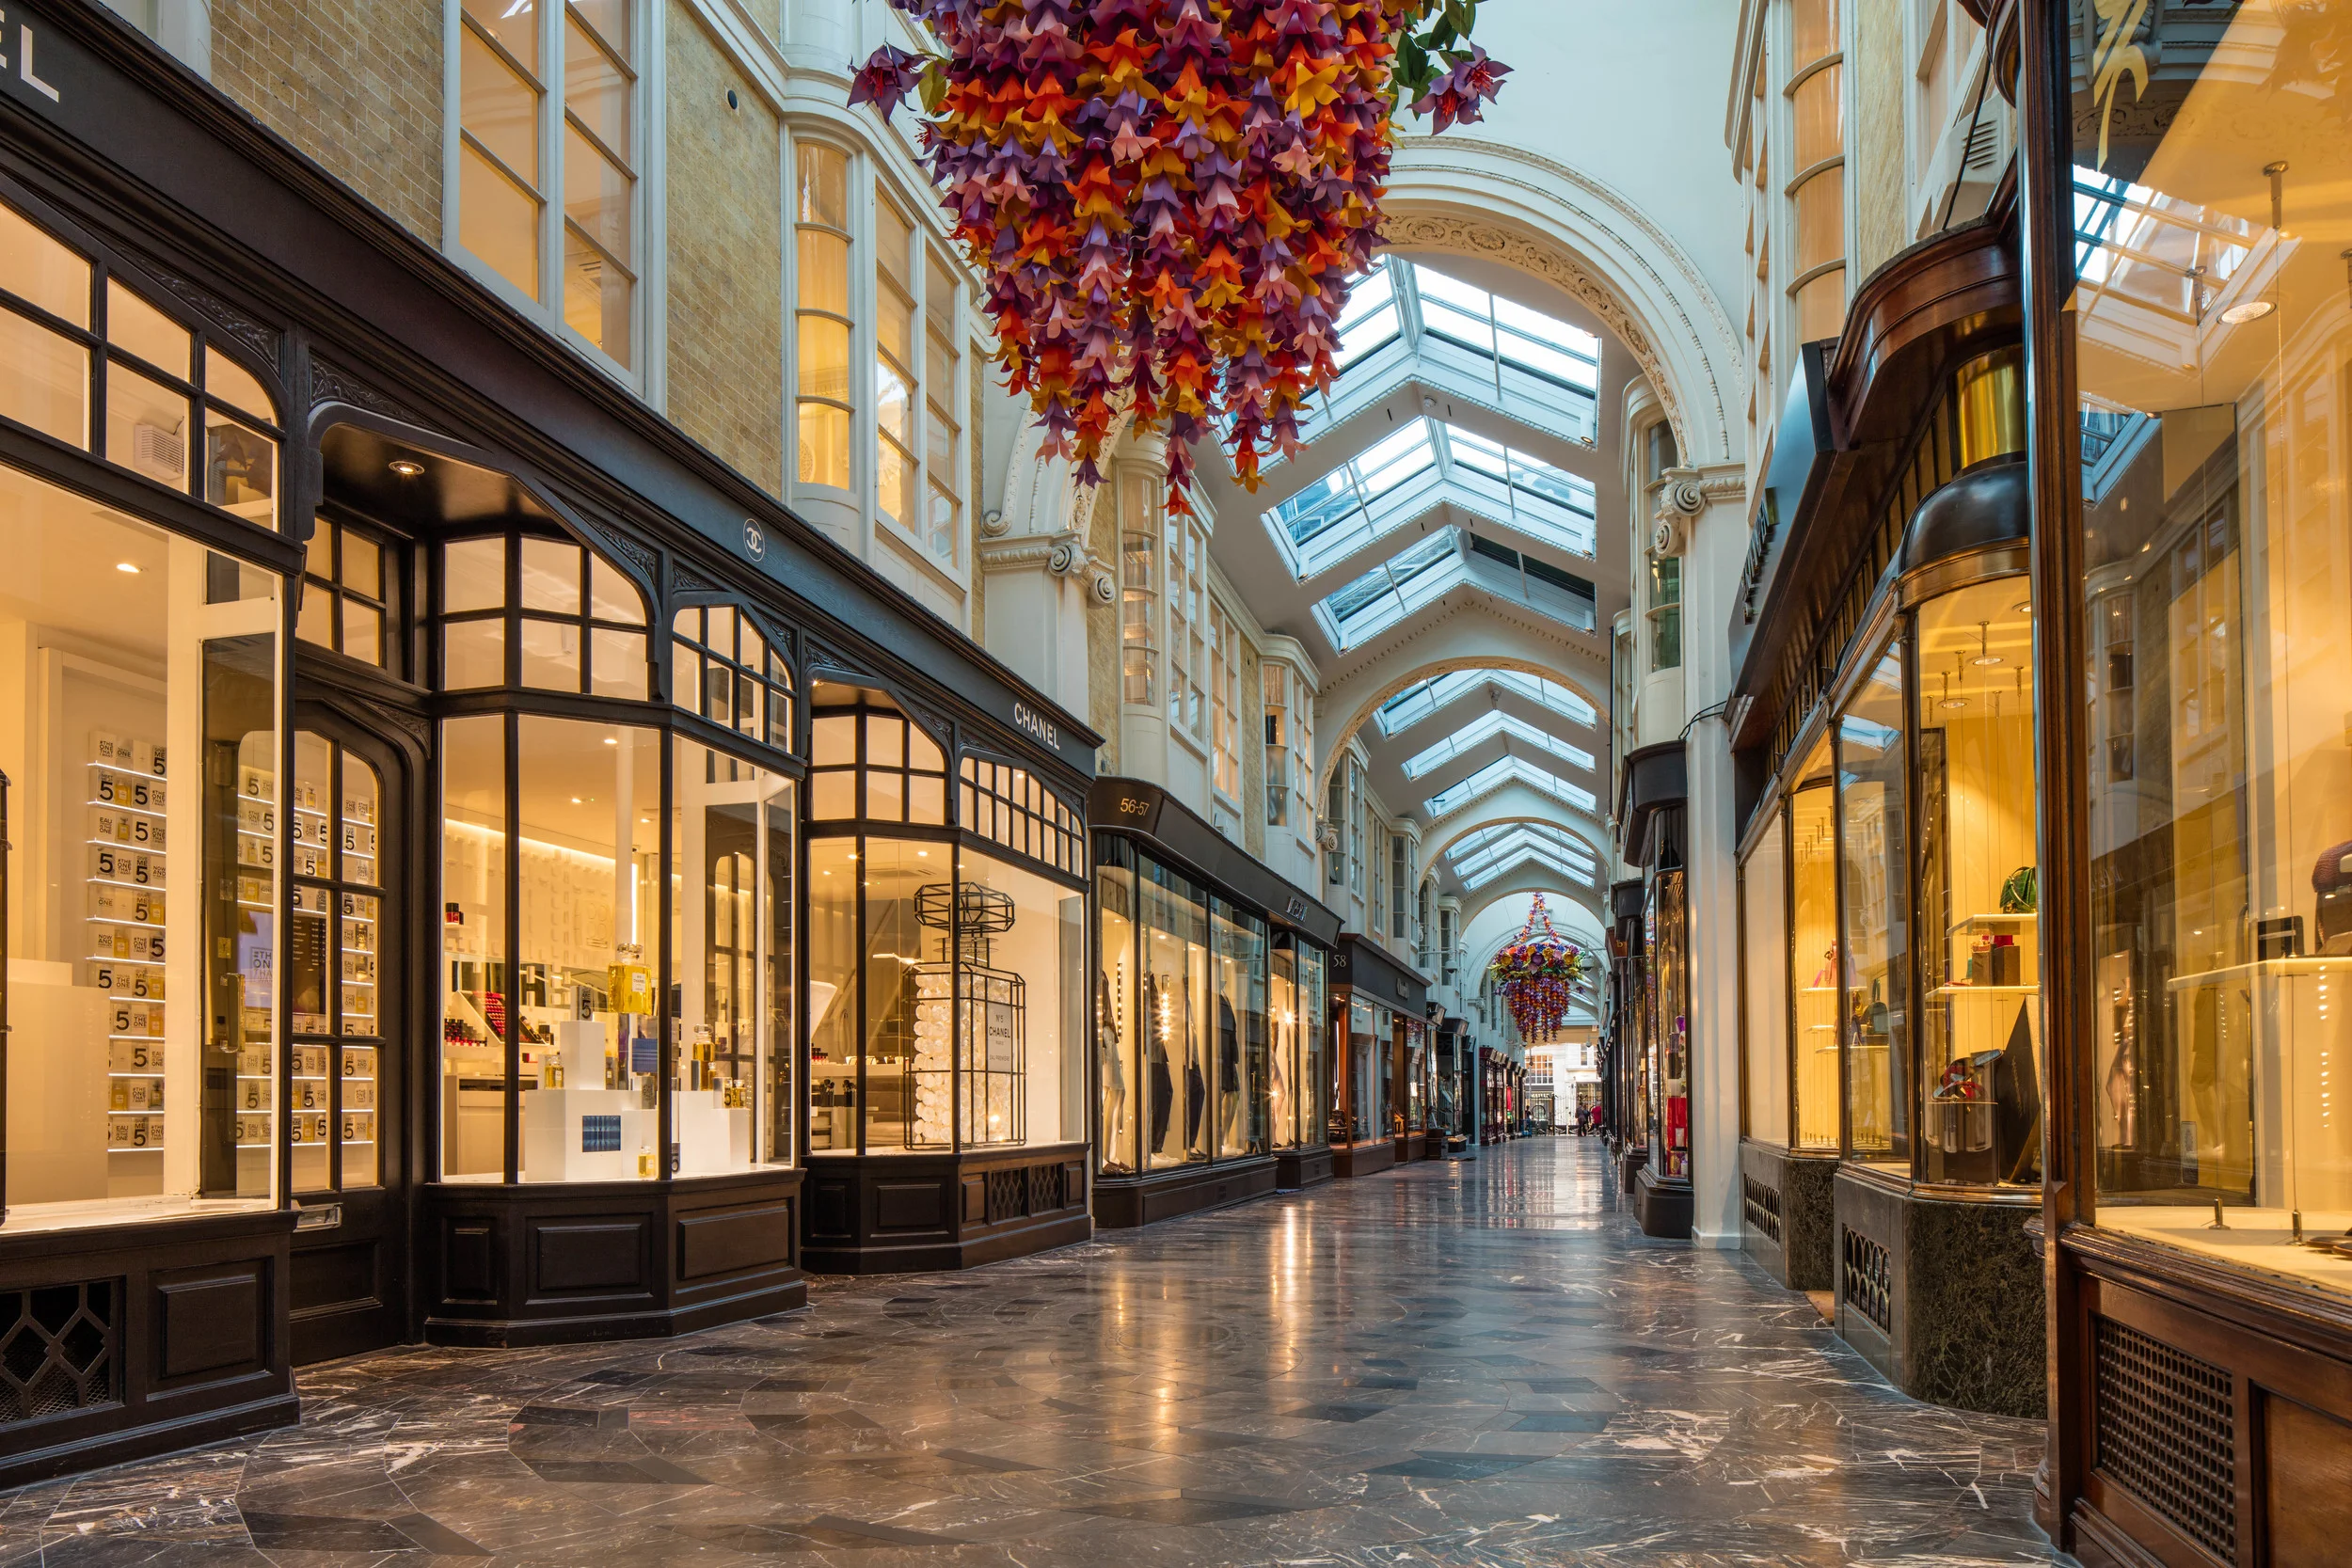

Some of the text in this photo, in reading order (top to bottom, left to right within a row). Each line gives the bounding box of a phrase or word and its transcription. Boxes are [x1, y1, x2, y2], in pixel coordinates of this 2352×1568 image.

[0, 8, 59, 103] L
[1014, 702, 1060, 751] CHANEL
[153, 757, 166, 775] 5
[100, 781, 114, 800] 5
[135, 784, 148, 805] 5
[248, 778, 259, 796] 5
[1120, 798, 1150, 816] 56-57
[135, 821, 148, 841] 5
[263, 814, 274, 831] 5
[345, 835, 355, 850] 5
[99, 853, 113, 873] 5
[262, 846, 273, 863] 5
[135, 865, 148, 883] 5
[306, 861, 315, 876] 5
[135, 903, 148, 921] 5
[343, 899, 353, 914] 5
[151, 938, 165, 958] 5
[1333, 954, 1346, 968] 58
[98, 970, 112, 989] 5
[135, 979, 147, 996] 5
[581, 999, 592, 1019] 5
[116, 1011, 130, 1030] 5
[988, 1025, 1010, 1038] CHANEL
[134, 1049, 148, 1068] 5
[262, 1059, 271, 1073] 5
[293, 1053, 301, 1070] 5
[344, 1060, 354, 1075] 5
[248, 1093, 258, 1109] 5
[304, 1091, 313, 1107] 5
[723, 1087, 732, 1106] 5
[293, 1127, 301, 1142] 5
[318, 1120, 326, 1136] 5
[343, 1123, 354, 1139] 5
[134, 1129, 146, 1147] 5
